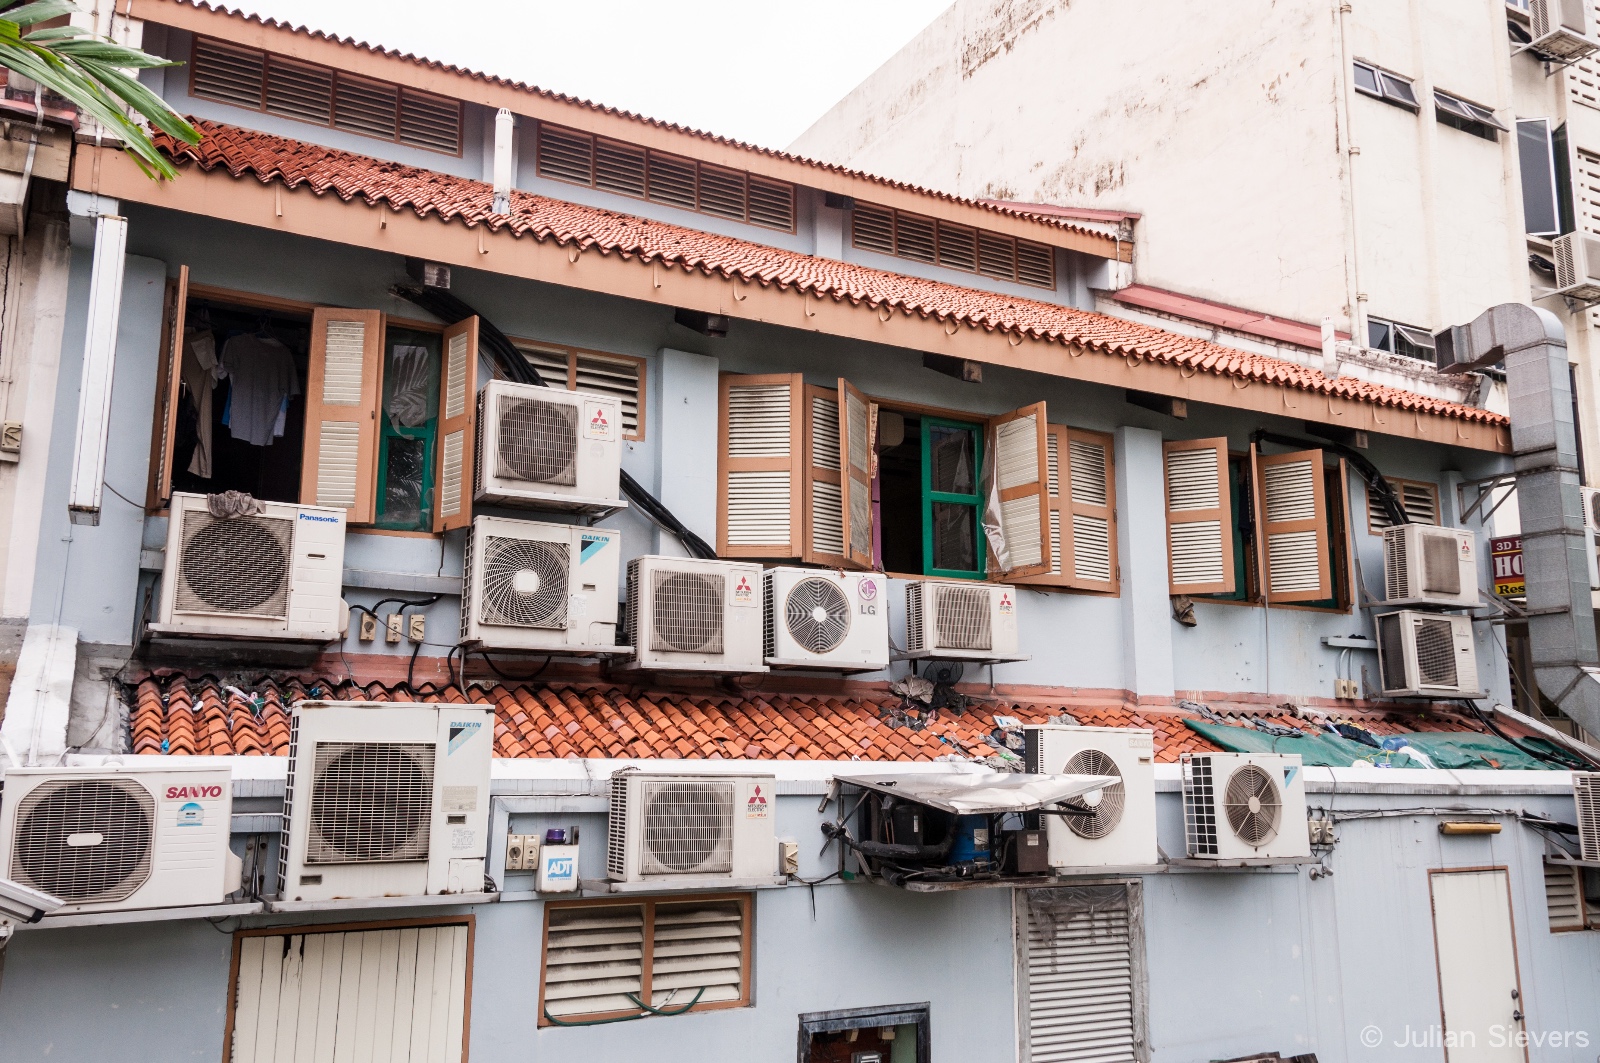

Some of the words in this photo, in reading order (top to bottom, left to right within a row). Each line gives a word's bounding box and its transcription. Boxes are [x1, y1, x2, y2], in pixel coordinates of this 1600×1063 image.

[299, 513, 339, 523] Panasonic
[581, 534, 610, 542] DAIKIN
[1496, 541, 1512, 551] 3D
[1498, 585, 1525, 595] Res
[860, 605, 876, 615] LG
[1129, 739, 1152, 748] SANYO
[166, 786, 222, 799] SANYO
[548, 860, 572, 876] ADT
